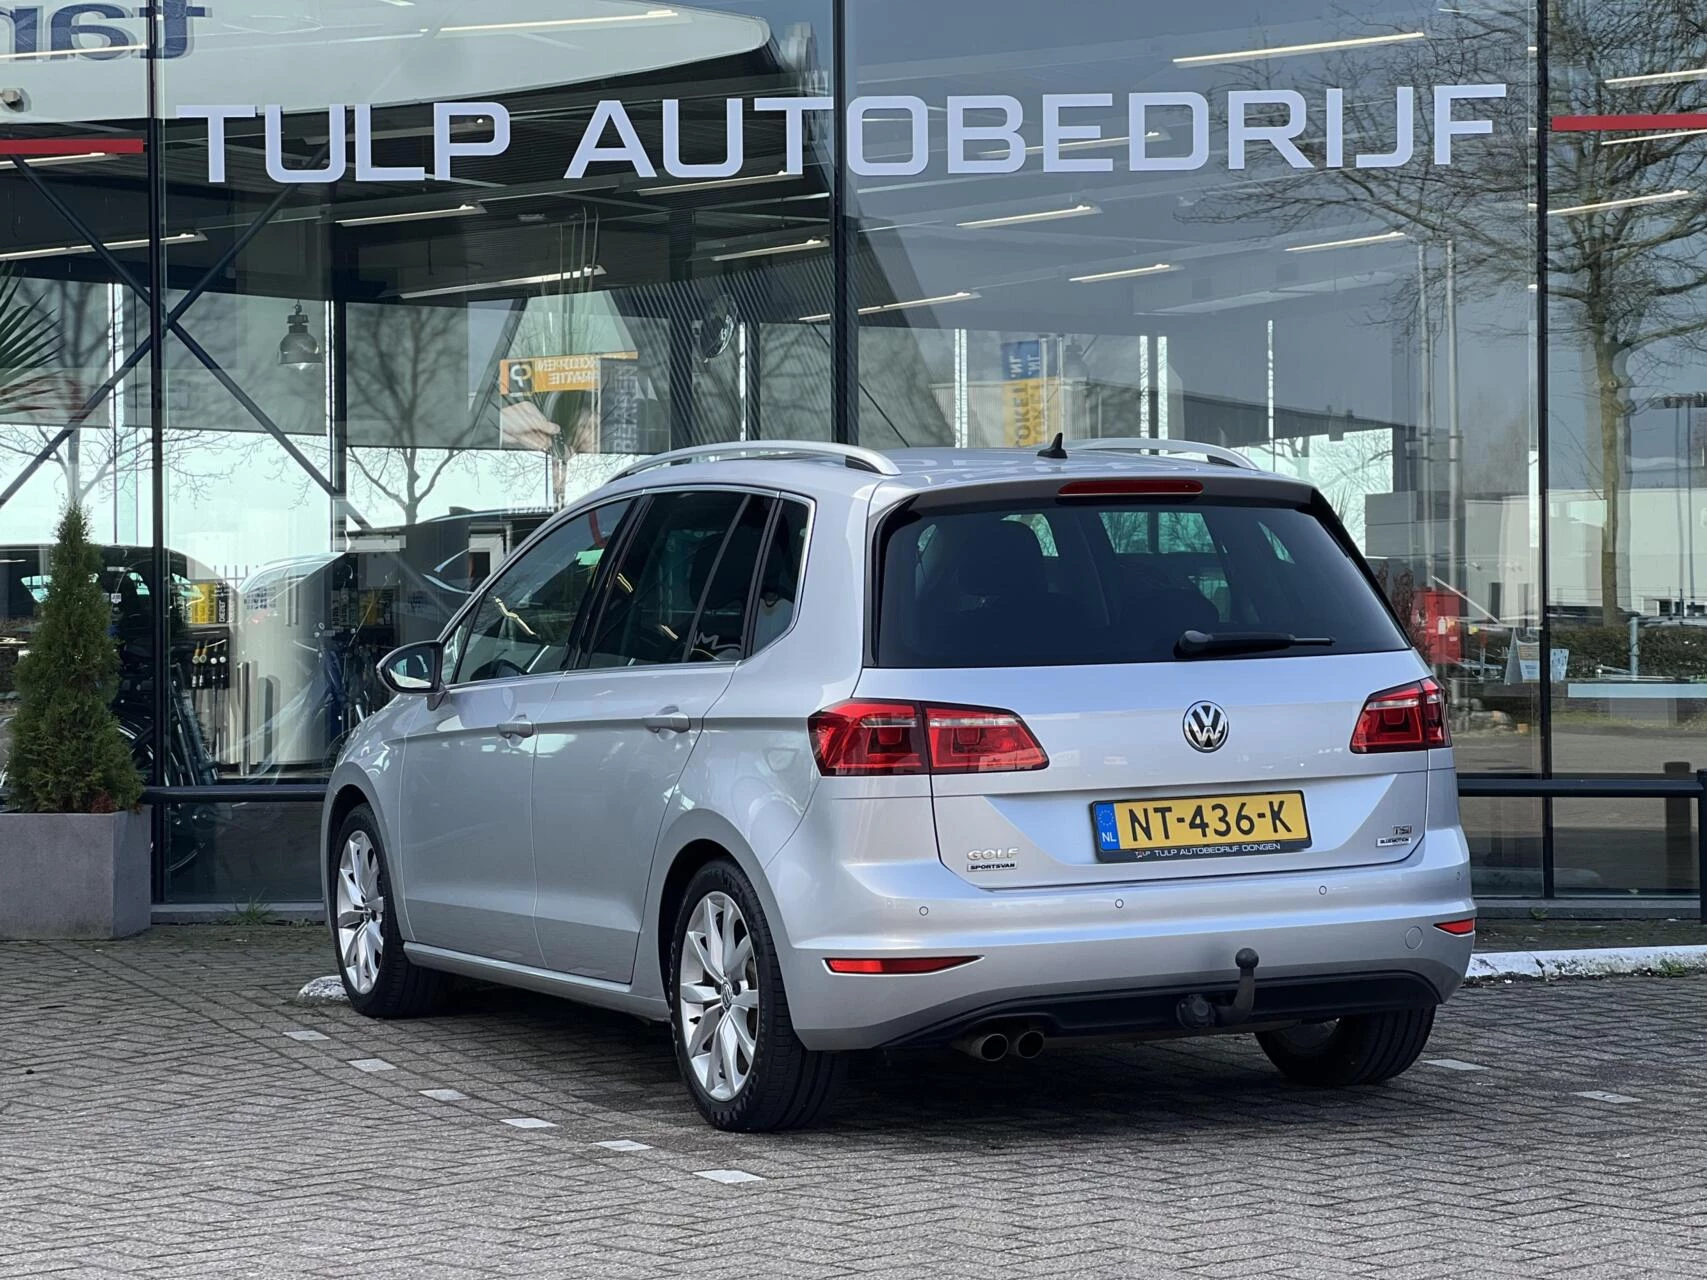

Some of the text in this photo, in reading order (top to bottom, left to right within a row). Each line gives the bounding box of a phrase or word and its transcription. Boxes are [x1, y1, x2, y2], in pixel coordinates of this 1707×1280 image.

[176, 83, 1506, 183] TULP AUTOBEDRIJF
[1128, 800, 1292, 842] NT-436-K
[1101, 831, 1117, 843] NL
[967, 848, 1019, 861] GOLF
[1154, 842, 1281, 857] TULP AUTOBEDRIJF DONGEN
